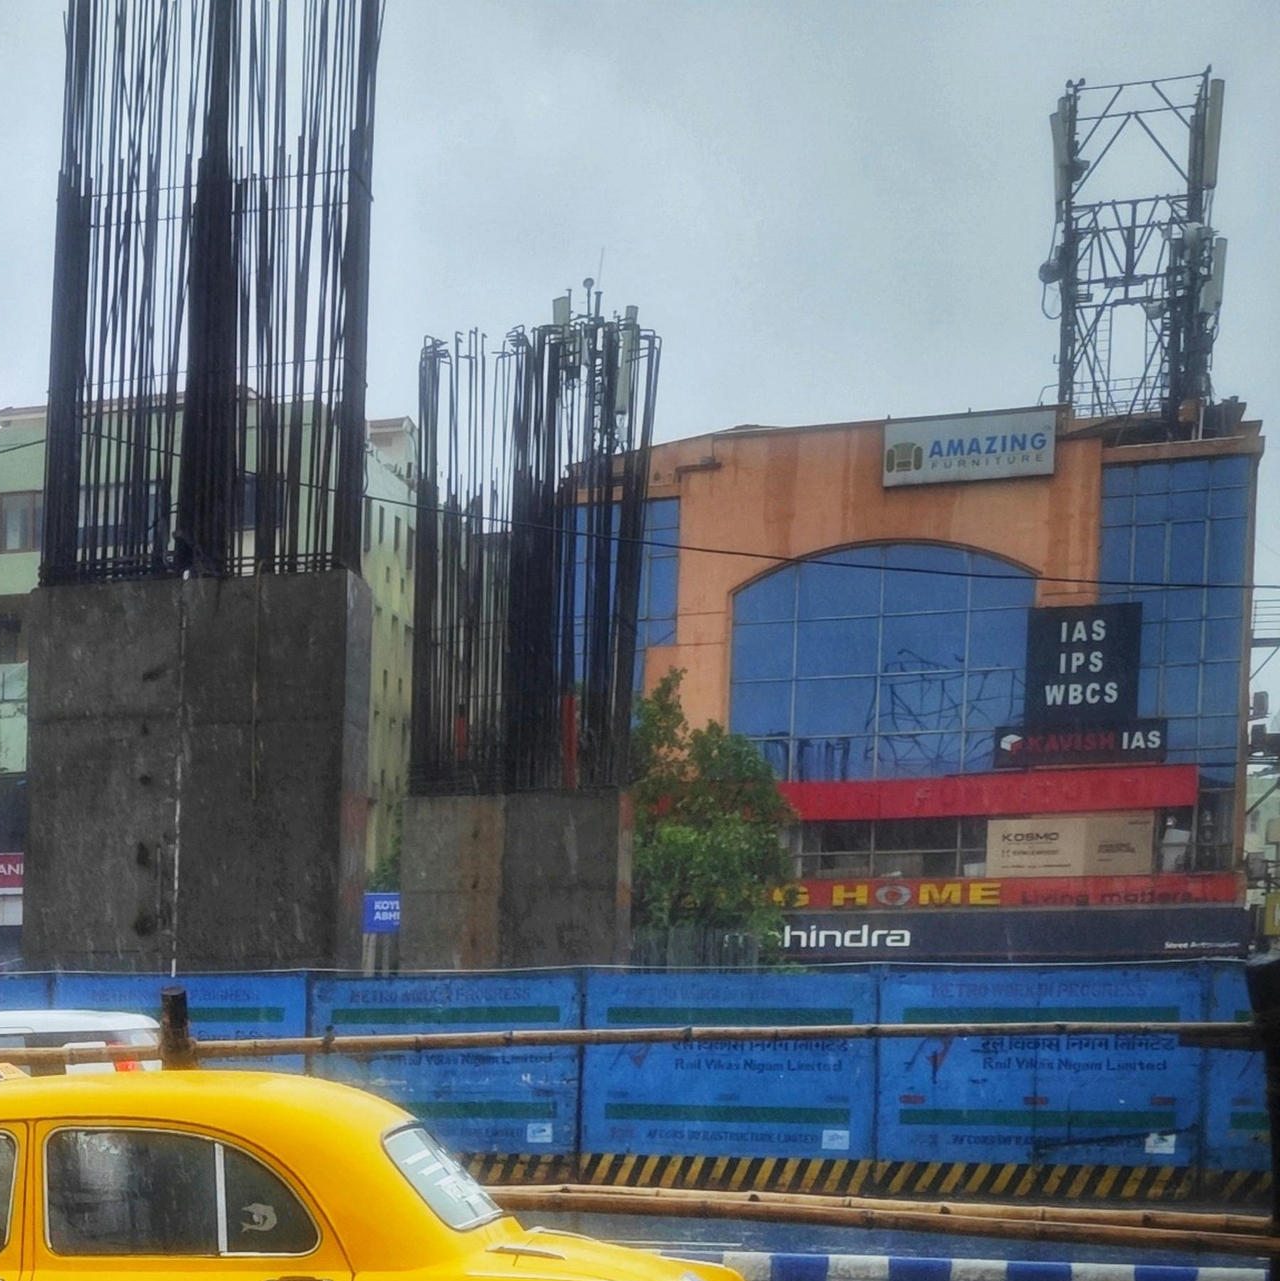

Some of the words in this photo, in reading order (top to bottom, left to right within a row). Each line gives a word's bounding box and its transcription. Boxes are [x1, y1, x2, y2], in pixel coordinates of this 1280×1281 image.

[929, 431, 1047, 458] AMAZING
[931, 453, 1042, 470] FURNITURE
[1060, 619, 1106, 643] IAS
[1059, 651, 1104, 674] IPS
[1044, 682, 1119, 706] WBCS
[1028, 732, 1115, 752] KAVISH
[1122, 730, 1161, 750] IAS
[1001, 831, 1060, 843] KOSMO
[832, 882, 1002, 907] HOME
[1057, 982, 1148, 997] PROGRESS
[743, 1058, 784, 1074] Nigam
